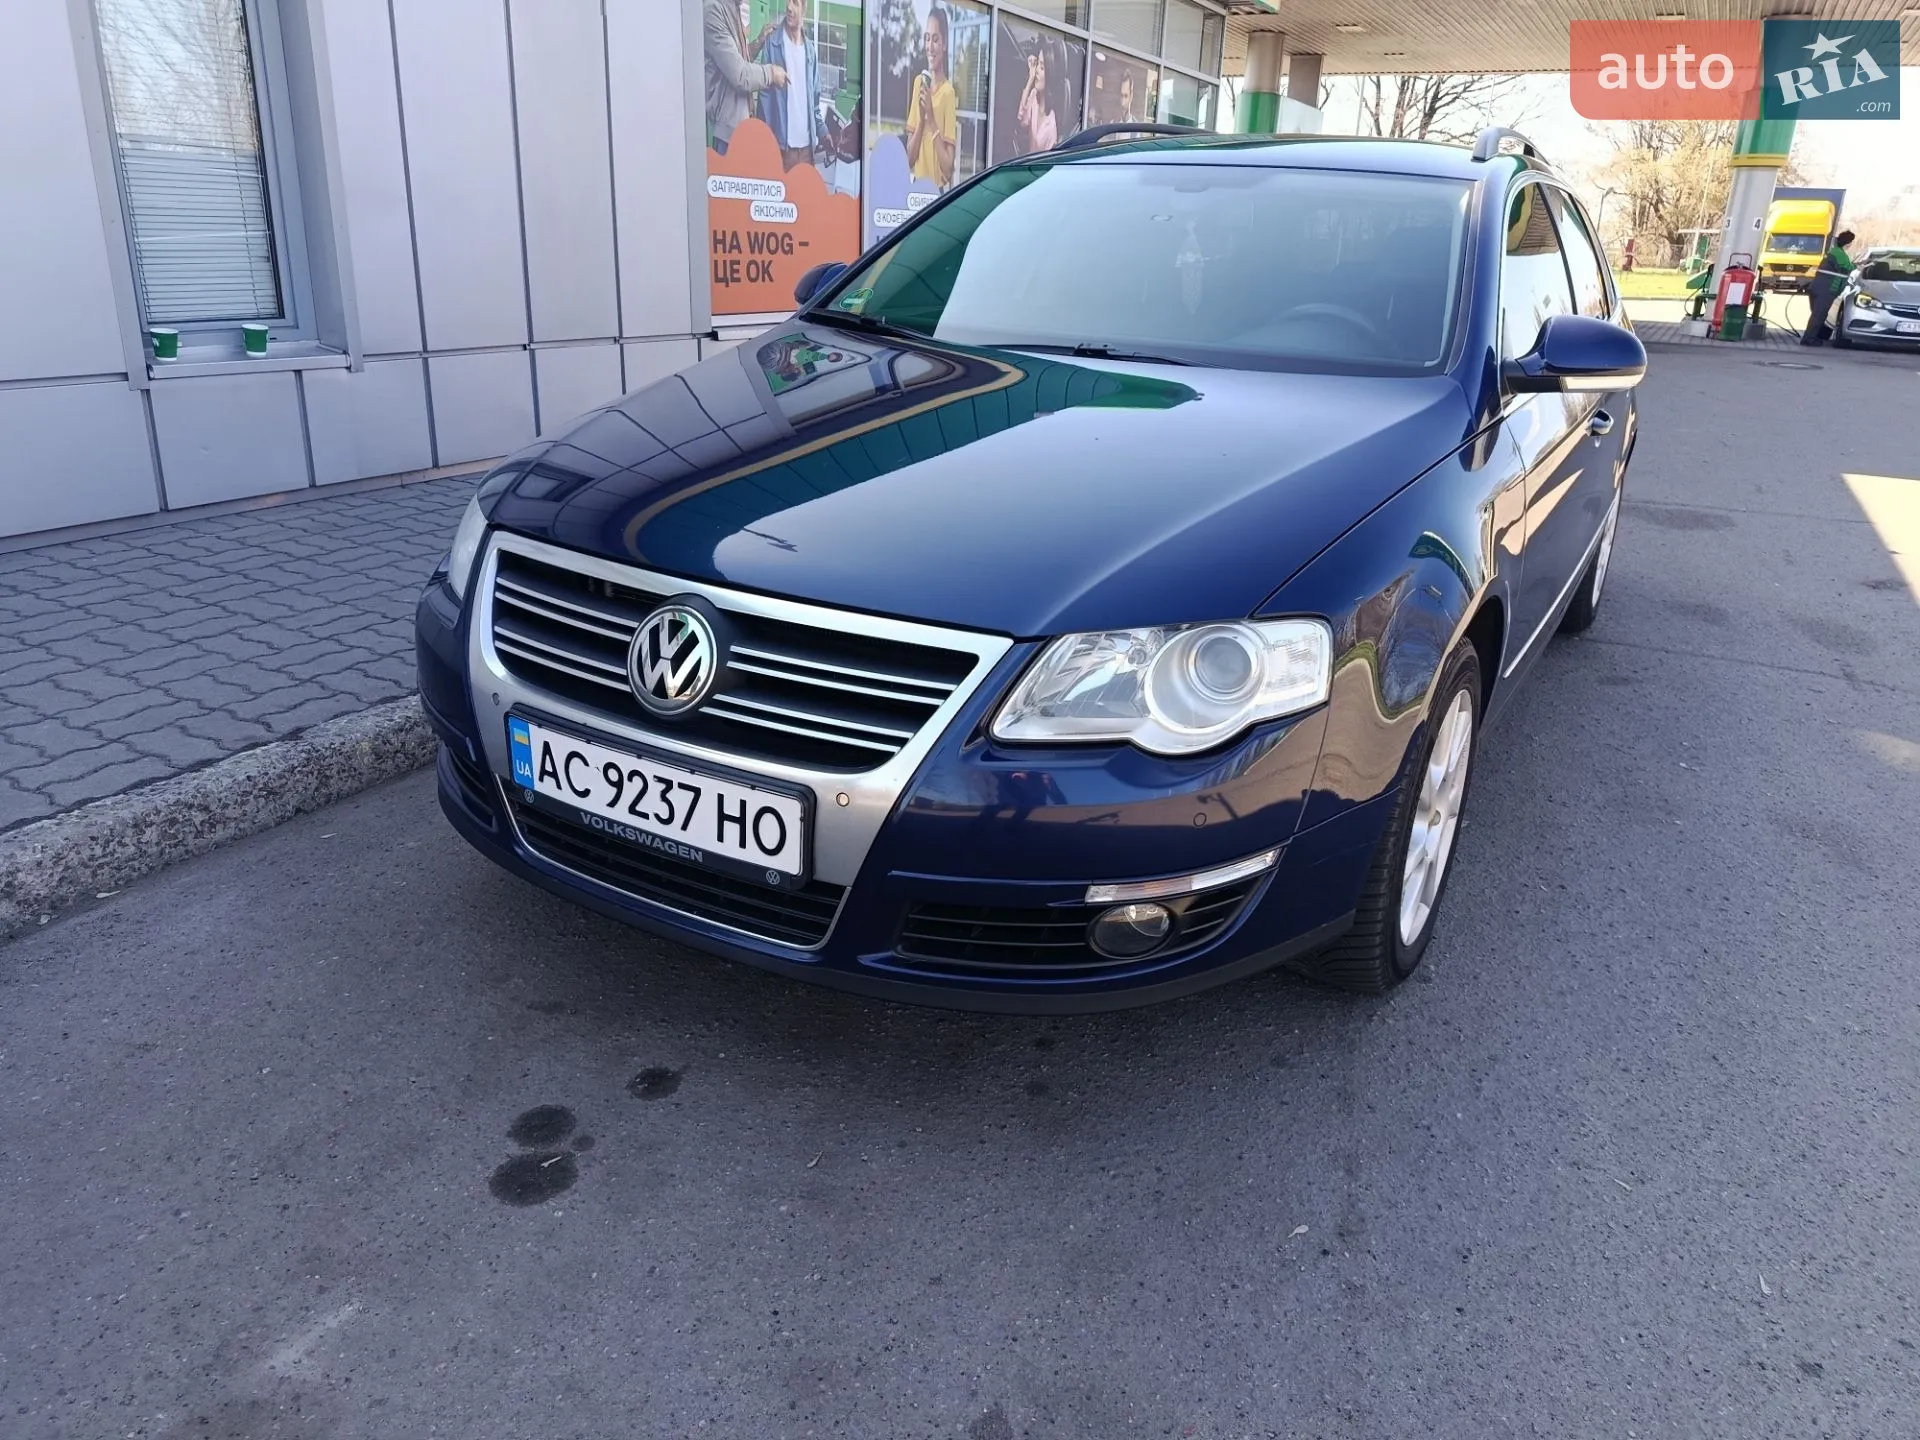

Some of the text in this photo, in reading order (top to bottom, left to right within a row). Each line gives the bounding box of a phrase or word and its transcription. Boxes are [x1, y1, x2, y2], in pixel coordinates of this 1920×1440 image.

[711, 180, 782, 197] ЗАПРАВЛЯТИСЯ
[754, 204, 794, 219] ЯКІСНИМ
[712, 230, 742, 254] НА
[746, 231, 794, 255] WOG
[713, 259, 742, 288] ЦЕ
[516, 759, 532, 779] UA
[538, 740, 592, 799] AC
[602, 761, 702, 832] 9237
[580, 811, 704, 863] VOLKSWAGEN
